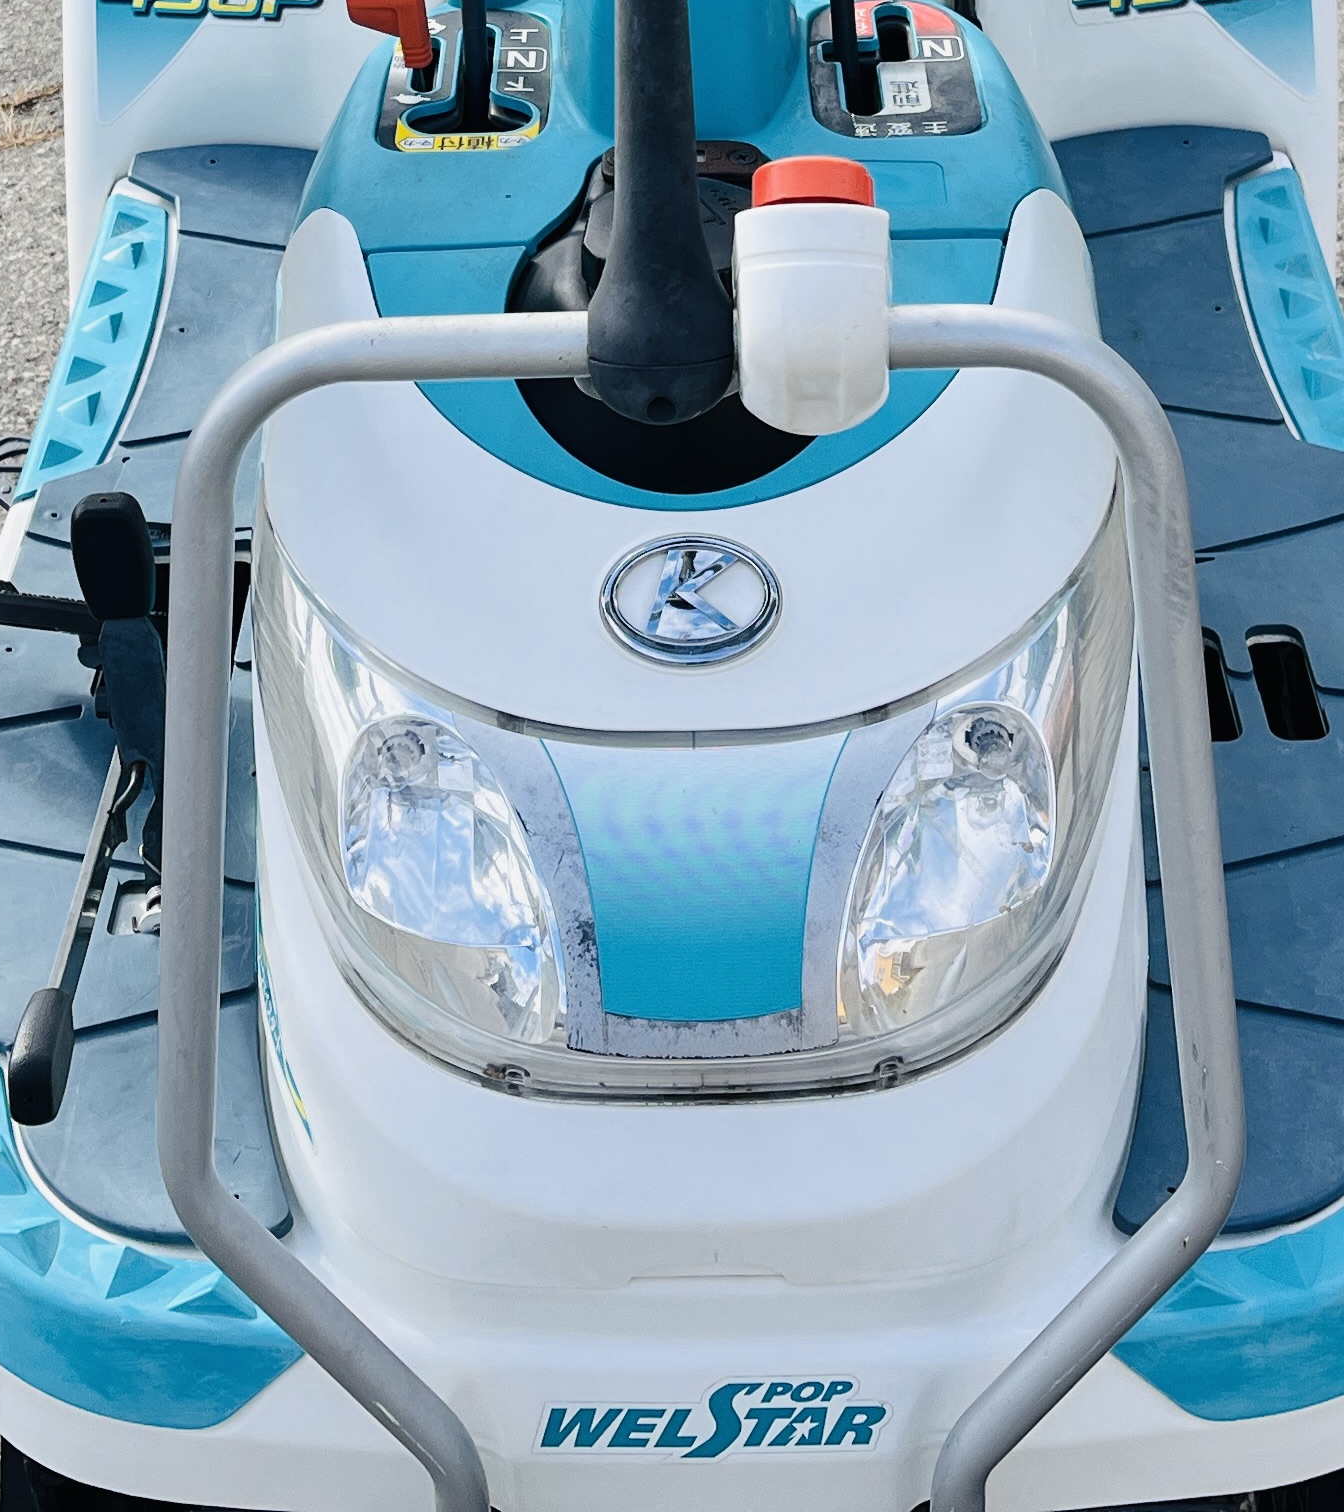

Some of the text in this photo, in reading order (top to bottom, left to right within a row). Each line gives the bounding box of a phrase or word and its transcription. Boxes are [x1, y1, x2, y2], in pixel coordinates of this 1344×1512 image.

[506, 50, 537, 68] N
[921, 39, 954, 58] N
[889, 80, 922, 107] 前進
[760, 1380, 854, 1404] POP
[540, 1382, 887, 1458] WELSTAR
